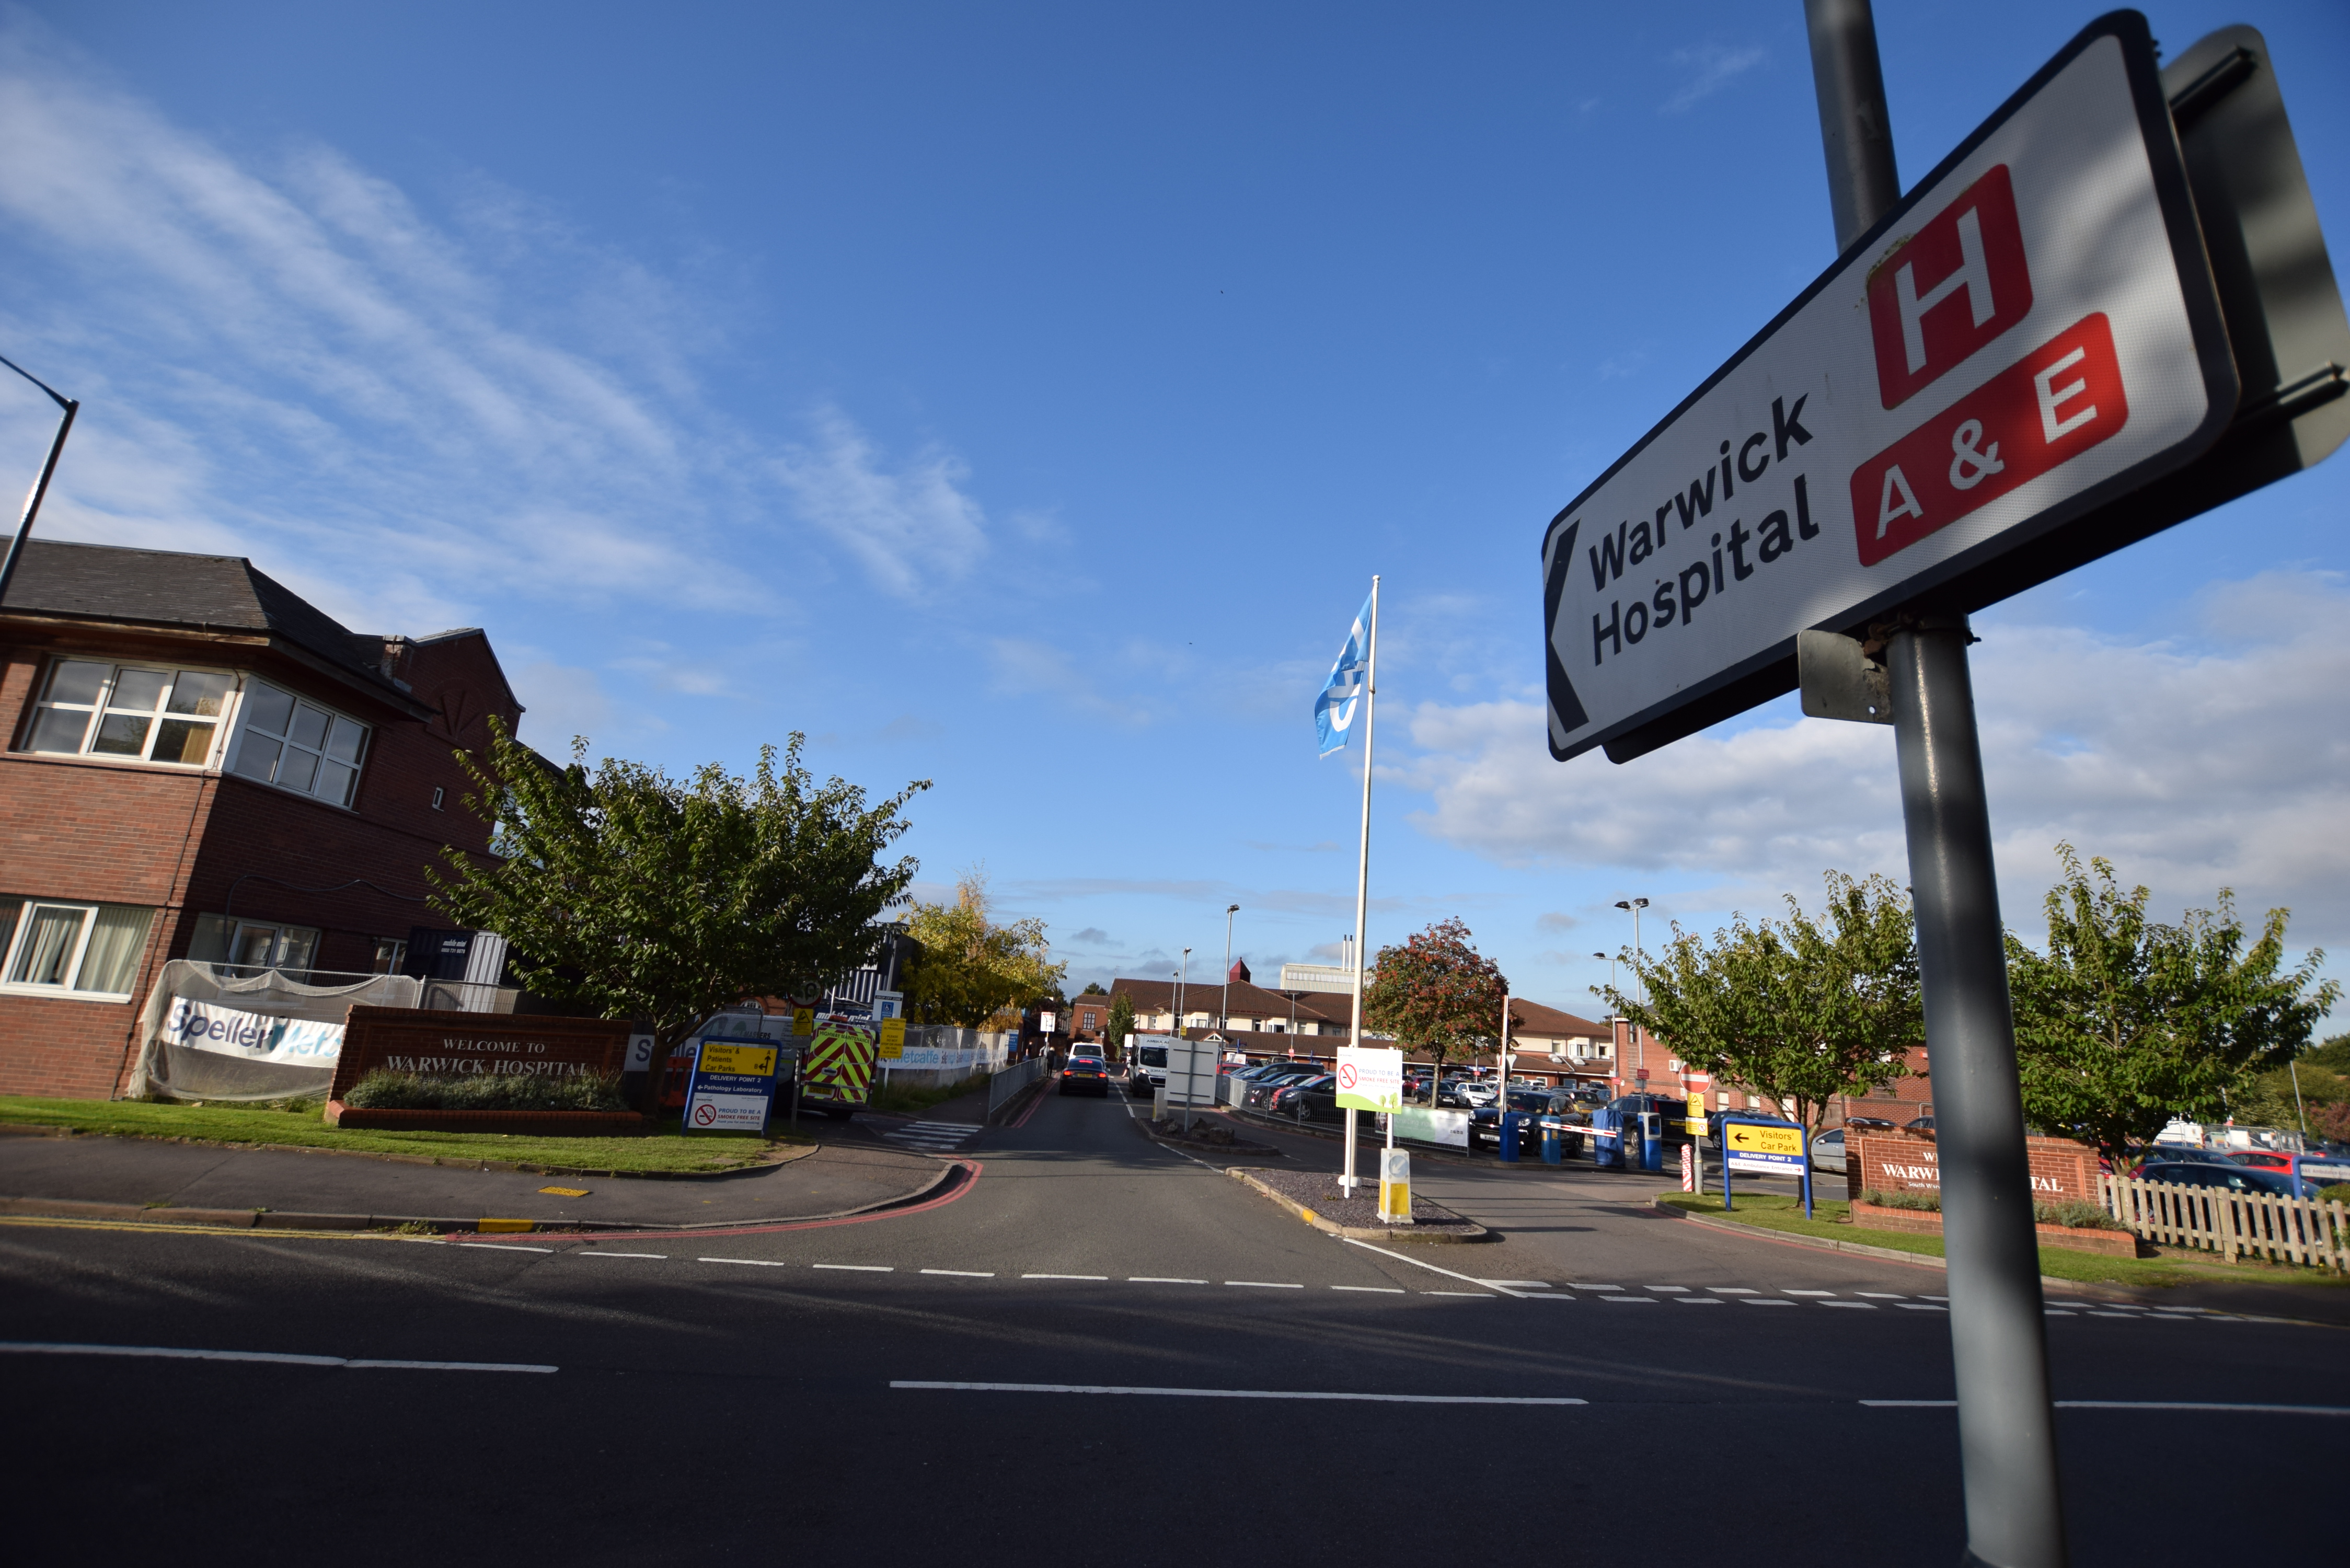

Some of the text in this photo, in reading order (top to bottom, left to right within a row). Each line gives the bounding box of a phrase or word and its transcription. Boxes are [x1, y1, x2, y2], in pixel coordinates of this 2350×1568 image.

[1894, 205, 1996, 377] H
[1875, 346, 2098, 540] A & E
[1588, 393, 1814, 593] Warwick
[1593, 474, 1820, 666] Hospital
[443, 1039, 545, 1053] WELCOME TO
[841, 1033, 870, 1044] MAINTENANCE
[387, 1056, 590, 1077] WARWICK HOSPITAL
[1761, 1142, 1797, 1152] Car Park
[1882, 1163, 1940, 1181] WARWI
